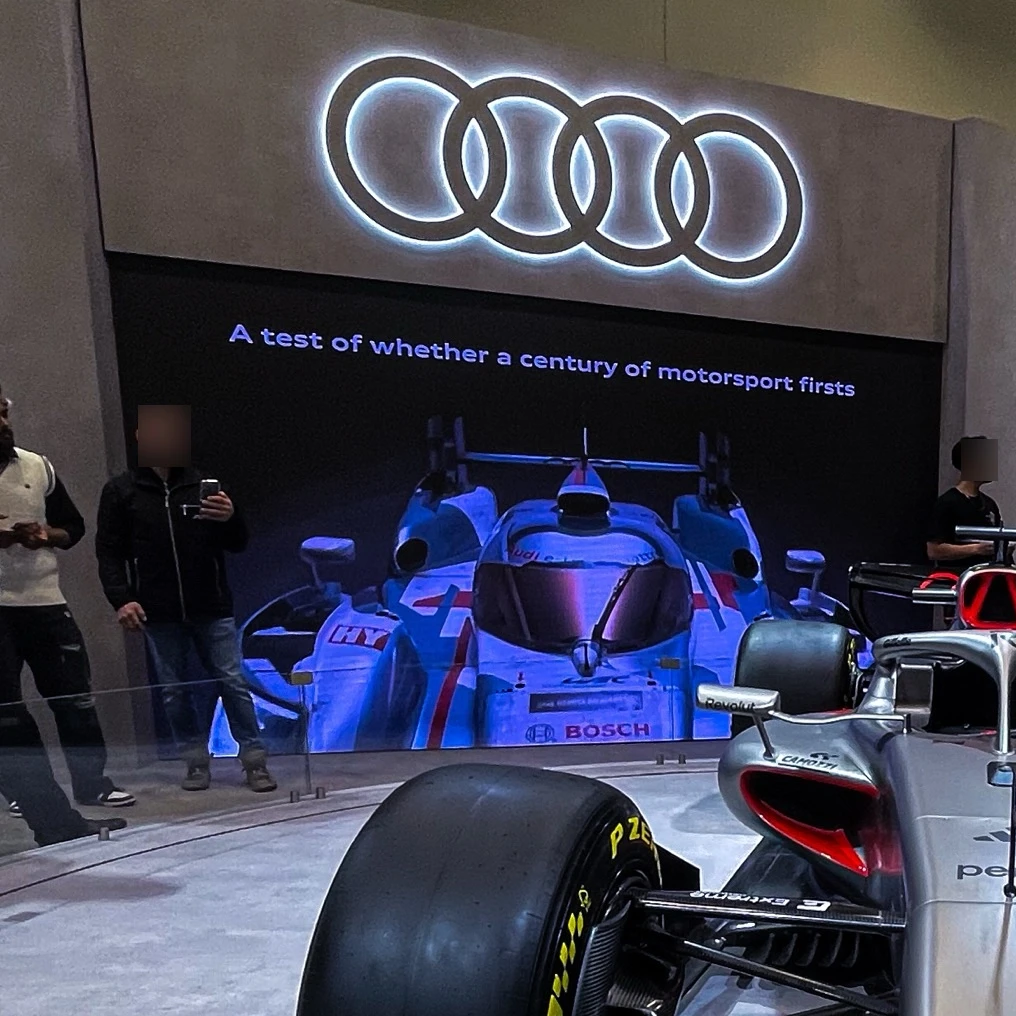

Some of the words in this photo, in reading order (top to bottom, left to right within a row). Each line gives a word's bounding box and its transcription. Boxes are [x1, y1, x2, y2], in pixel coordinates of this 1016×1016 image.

[229, 323, 254, 343] A
[261, 327, 323, 350] test
[332, 335, 362, 353] of
[370, 339, 488, 364] whether
[497, 351, 512, 365] a
[519, 350, 618, 379] century
[625, 361, 651, 377] of
[658, 363, 793, 392] motorsport
[800, 376, 855, 397] firsts
[705, 698, 756, 712] Revolut
[565, 723, 649, 739] BOSCH
